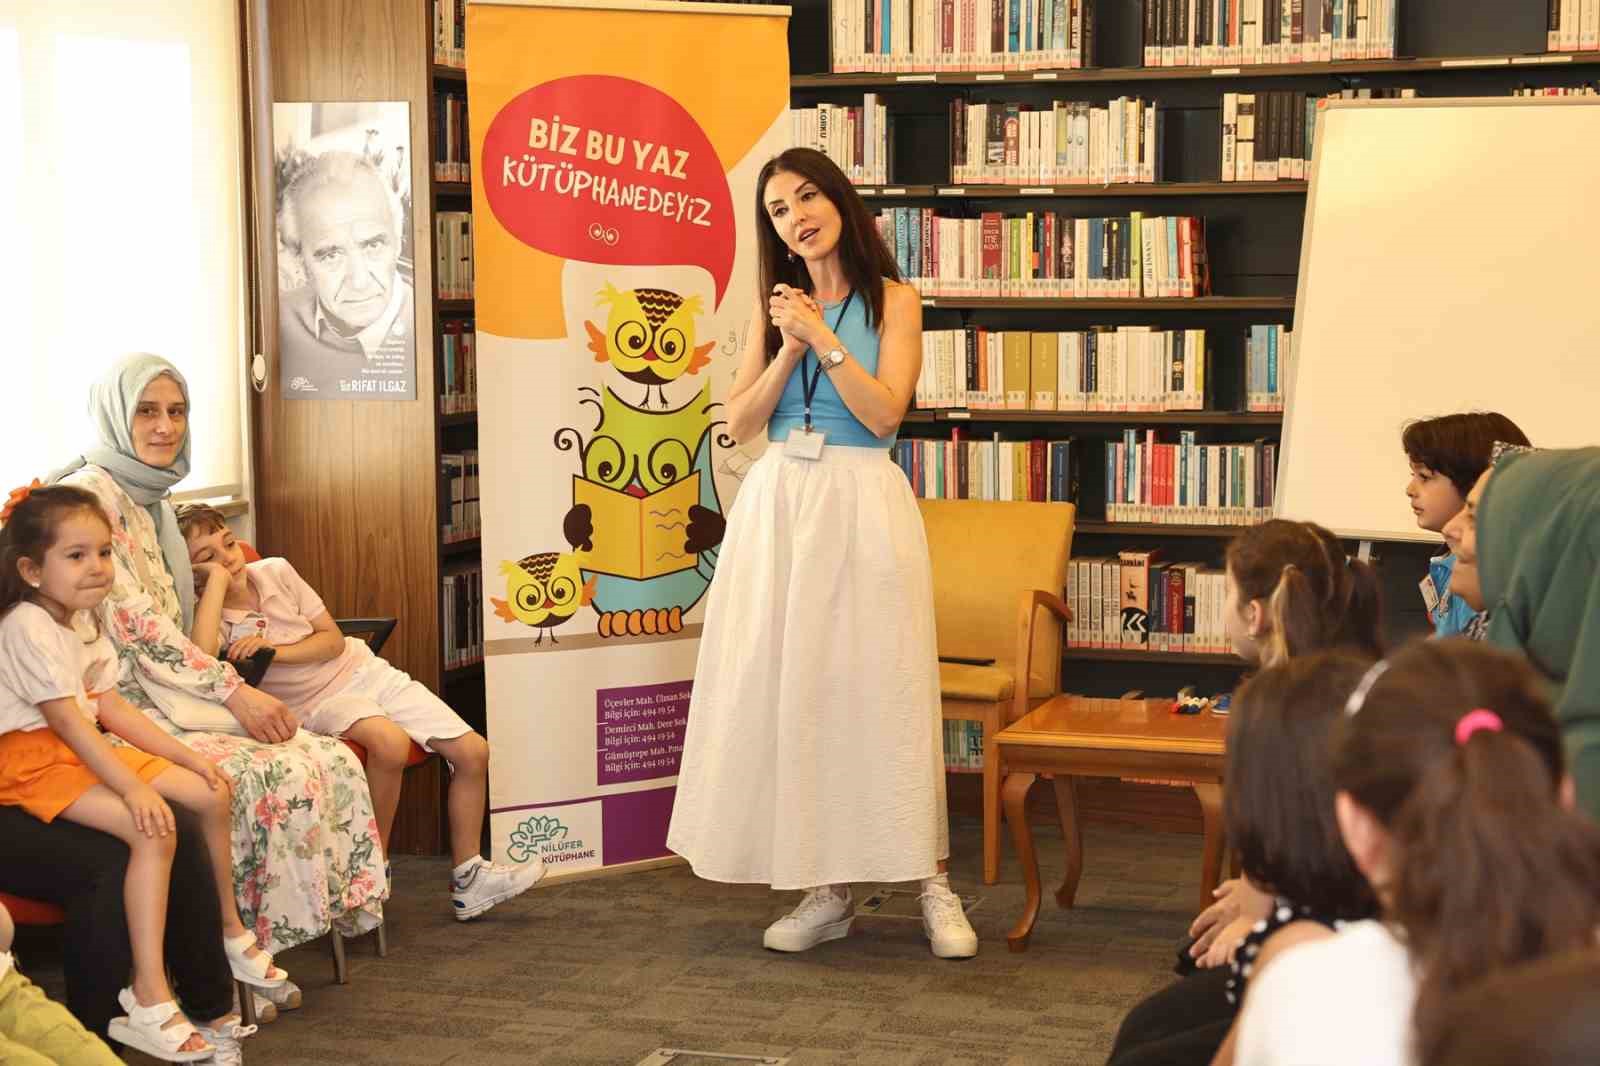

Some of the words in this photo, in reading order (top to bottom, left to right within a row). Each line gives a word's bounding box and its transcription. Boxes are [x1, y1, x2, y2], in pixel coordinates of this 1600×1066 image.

[528, 115, 580, 156] BİZ
[585, 129, 625, 165] BU
[632, 139, 690, 180] YAZ
[502, 153, 712, 227] KÜTÜPHANEDEYİZ
[351, 380, 376, 392] RIFAT
[379, 380, 407, 392] ILGAZ
[604, 709, 622, 719] Bilgi
[624, 707, 641, 719] için:
[604, 724, 637, 734] Demirci
[604, 735, 622, 745] Bilgi
[624, 733, 641, 745] için:
[604, 763, 622, 772] Bilgi
[624, 760, 641, 771] için:
[541, 840, 583, 852] NİLÜFER
[542, 850, 595, 863] KÜTÜPHANE
